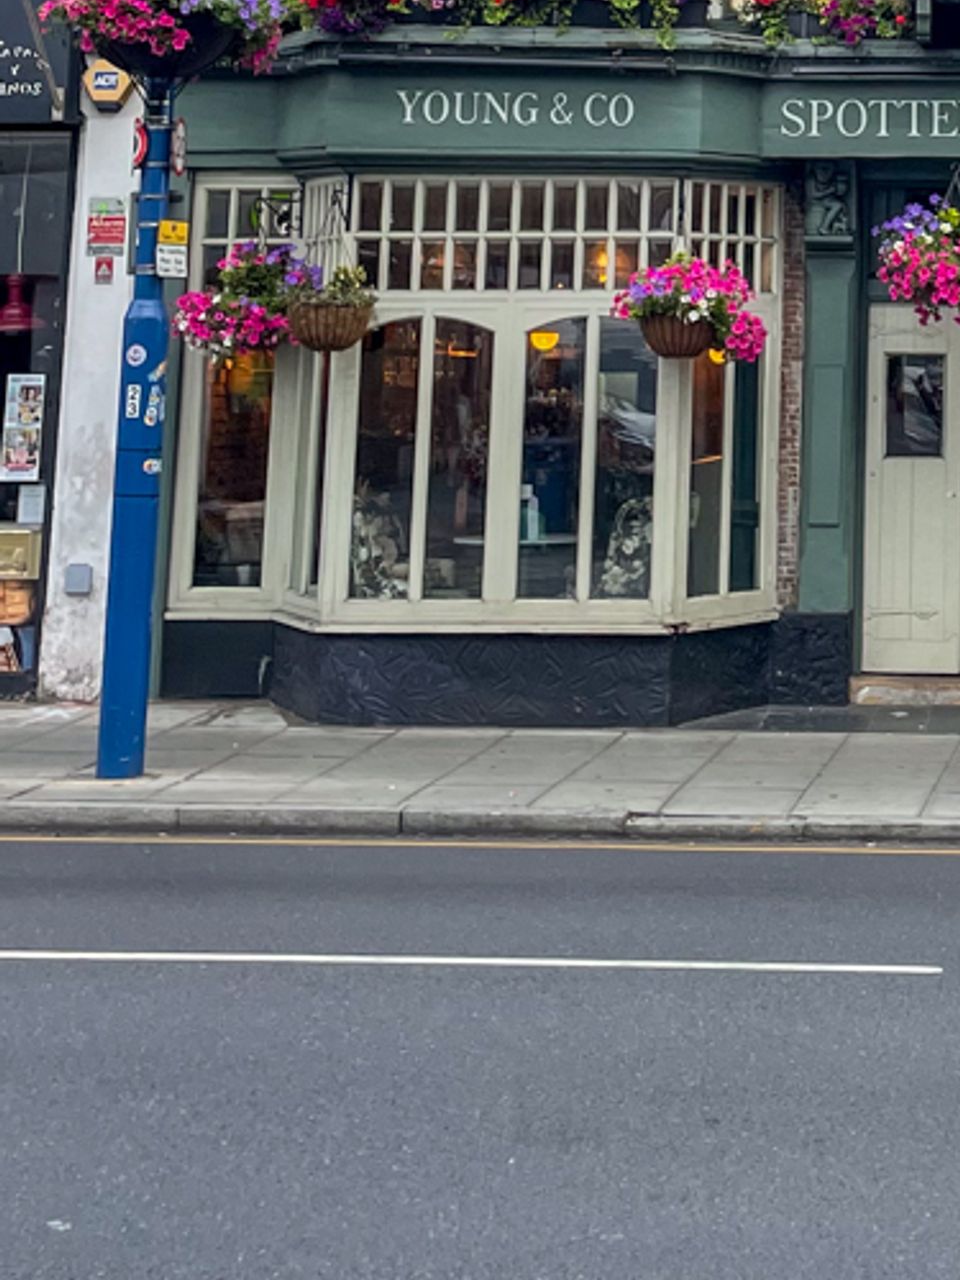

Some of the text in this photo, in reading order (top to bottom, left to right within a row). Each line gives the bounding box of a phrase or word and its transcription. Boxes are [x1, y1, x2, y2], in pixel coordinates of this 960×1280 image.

[396, 90, 635, 127] YOUNG & CO
